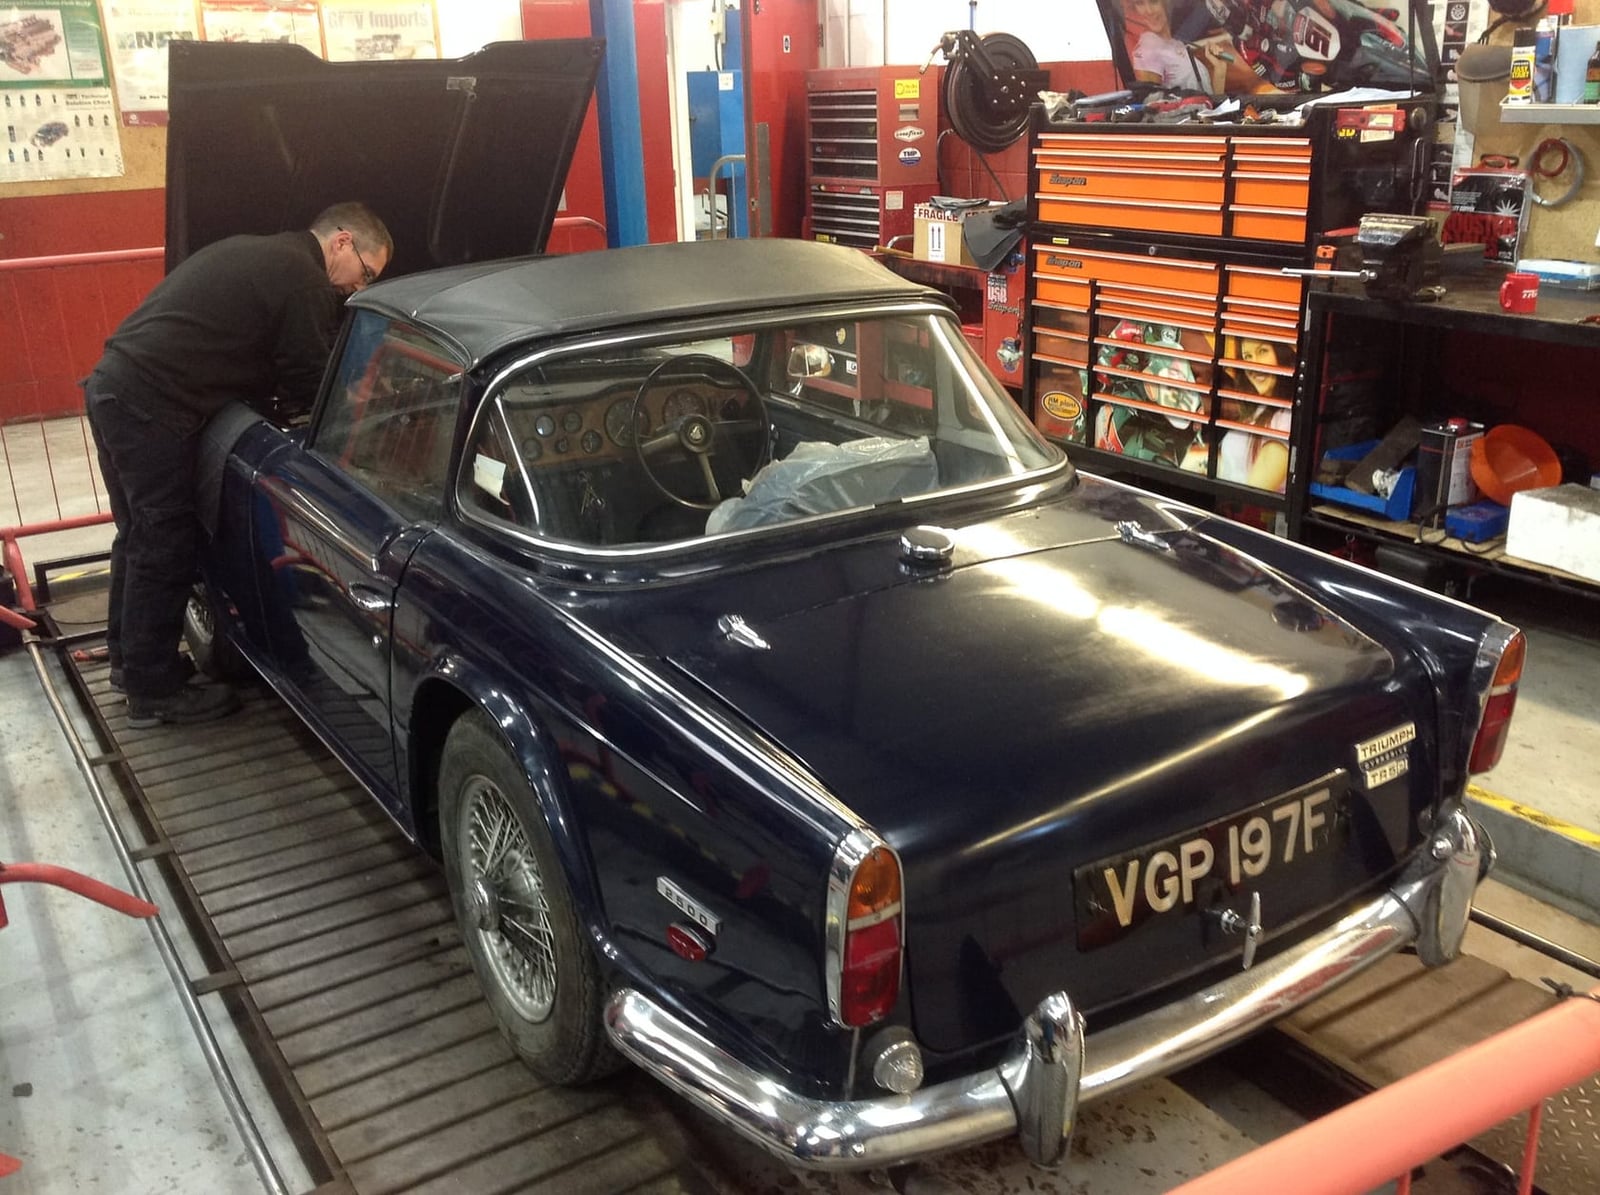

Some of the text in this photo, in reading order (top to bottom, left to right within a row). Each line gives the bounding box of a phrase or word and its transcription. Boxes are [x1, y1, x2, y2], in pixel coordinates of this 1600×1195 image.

[918, 208, 959, 222] FRAGILE
[1361, 726, 1415, 758] TRIUMPH
[1104, 788, 1330, 927] VGP 197F
[665, 886, 708, 926] 2500
